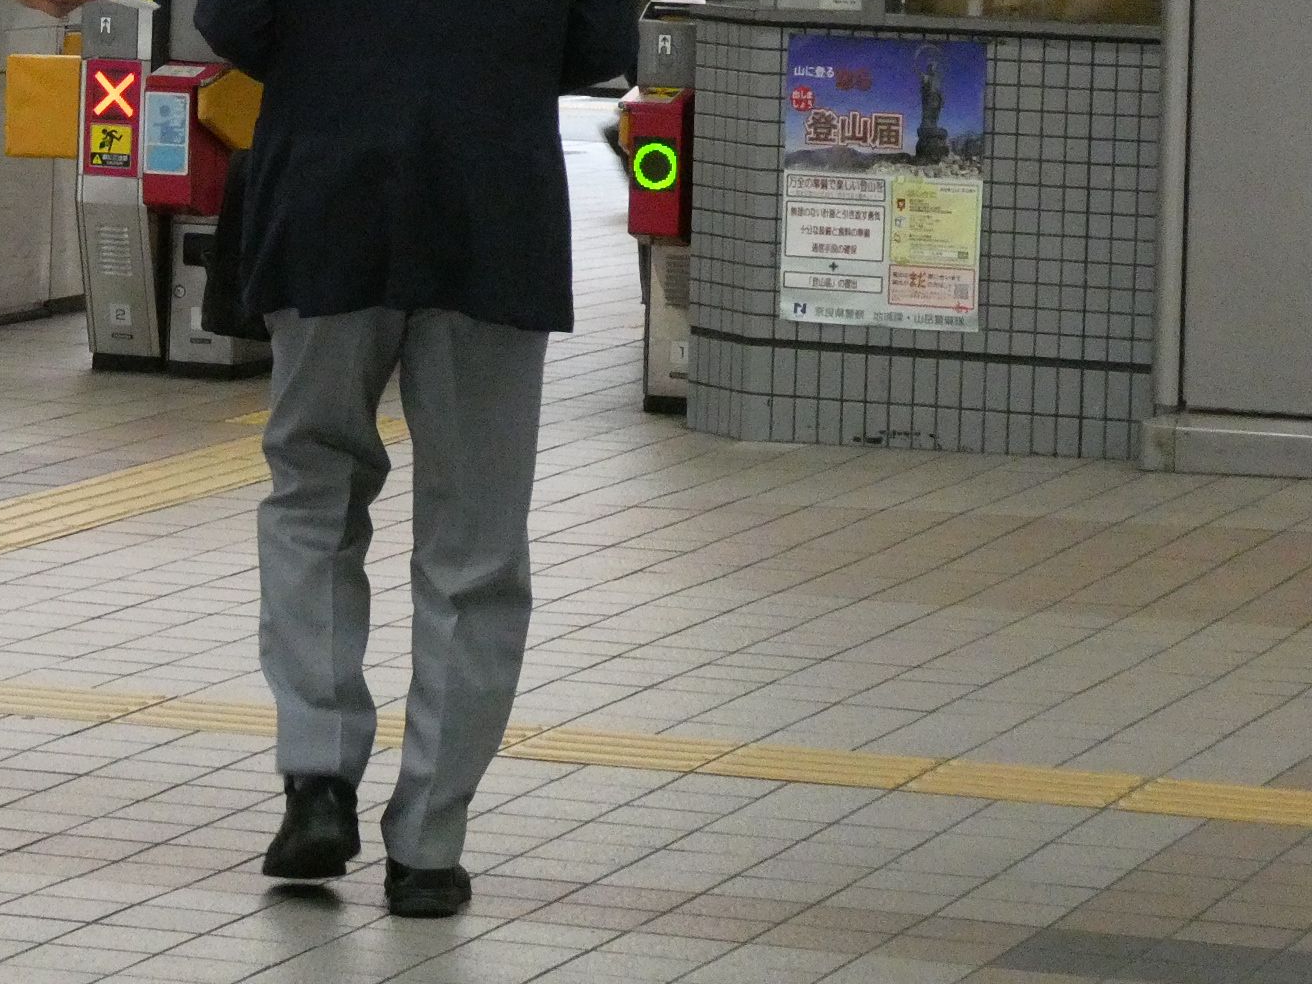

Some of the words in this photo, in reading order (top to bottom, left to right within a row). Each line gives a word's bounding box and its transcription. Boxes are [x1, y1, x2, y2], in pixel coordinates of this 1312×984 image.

[794, 66, 835, 78] 山に登る
[805, 109, 904, 150] 登山届
[115, 308, 126, 320] 2
